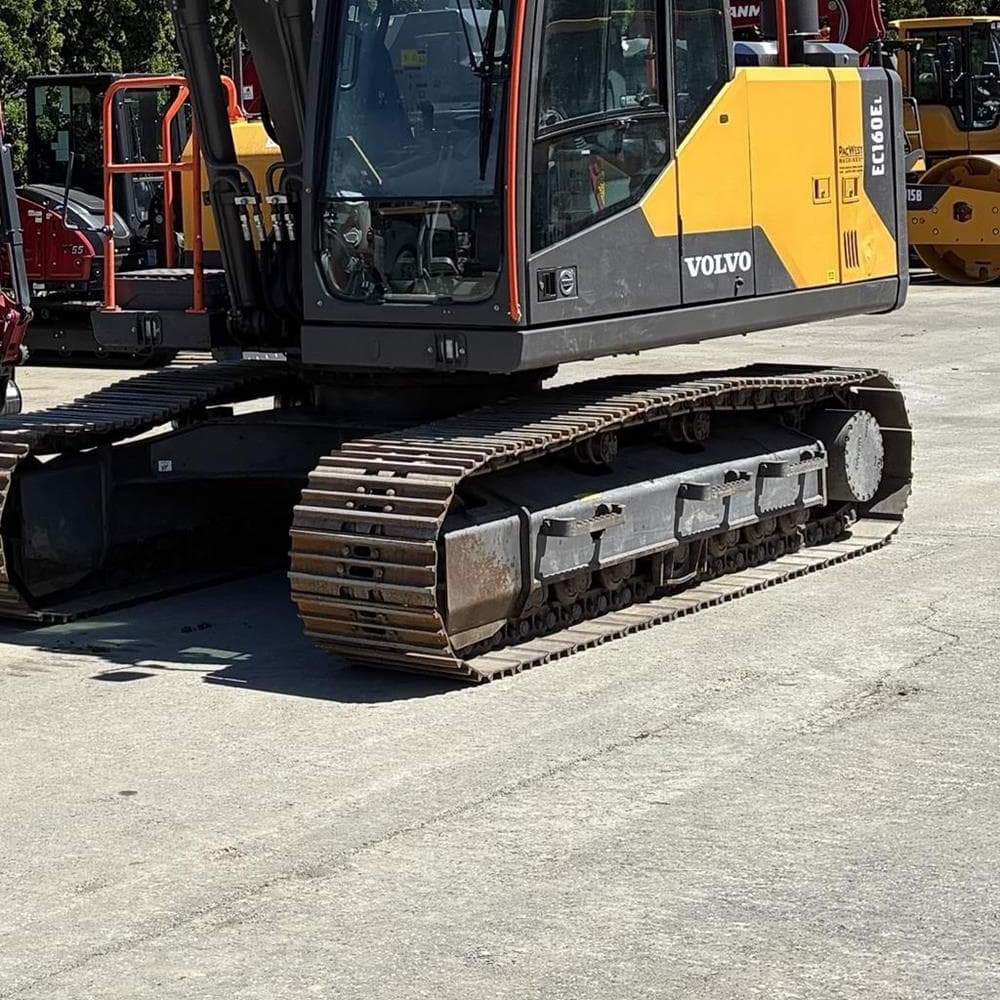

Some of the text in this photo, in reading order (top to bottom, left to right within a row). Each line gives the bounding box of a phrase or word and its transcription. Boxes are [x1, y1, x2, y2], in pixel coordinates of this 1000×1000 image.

[728, 5, 760, 17] ANM
[870, 96, 885, 176] EC160EL
[684, 250, 752, 277] VOLVO
